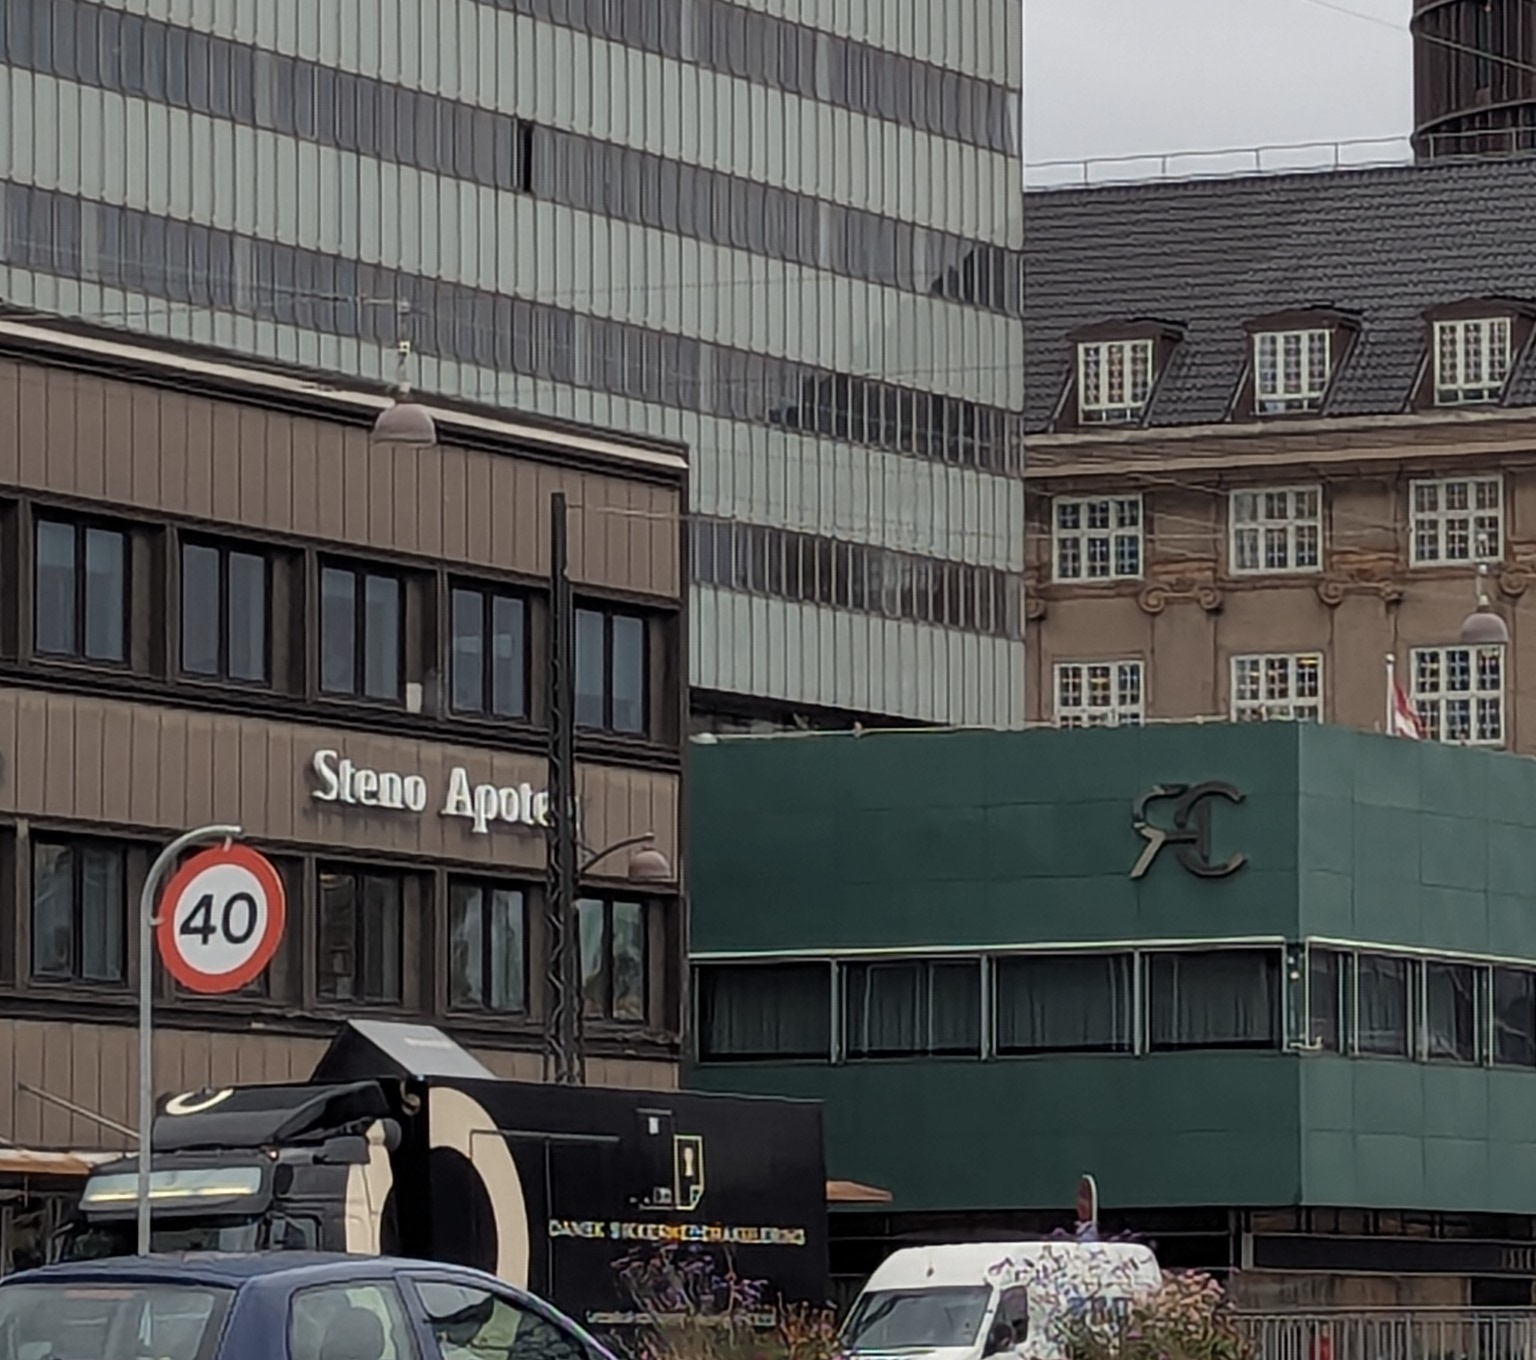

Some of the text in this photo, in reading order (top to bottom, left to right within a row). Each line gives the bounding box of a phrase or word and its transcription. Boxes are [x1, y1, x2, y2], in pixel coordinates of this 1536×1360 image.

[312, 749, 580, 834] Steno Apote
[179, 892, 258, 945] 40
